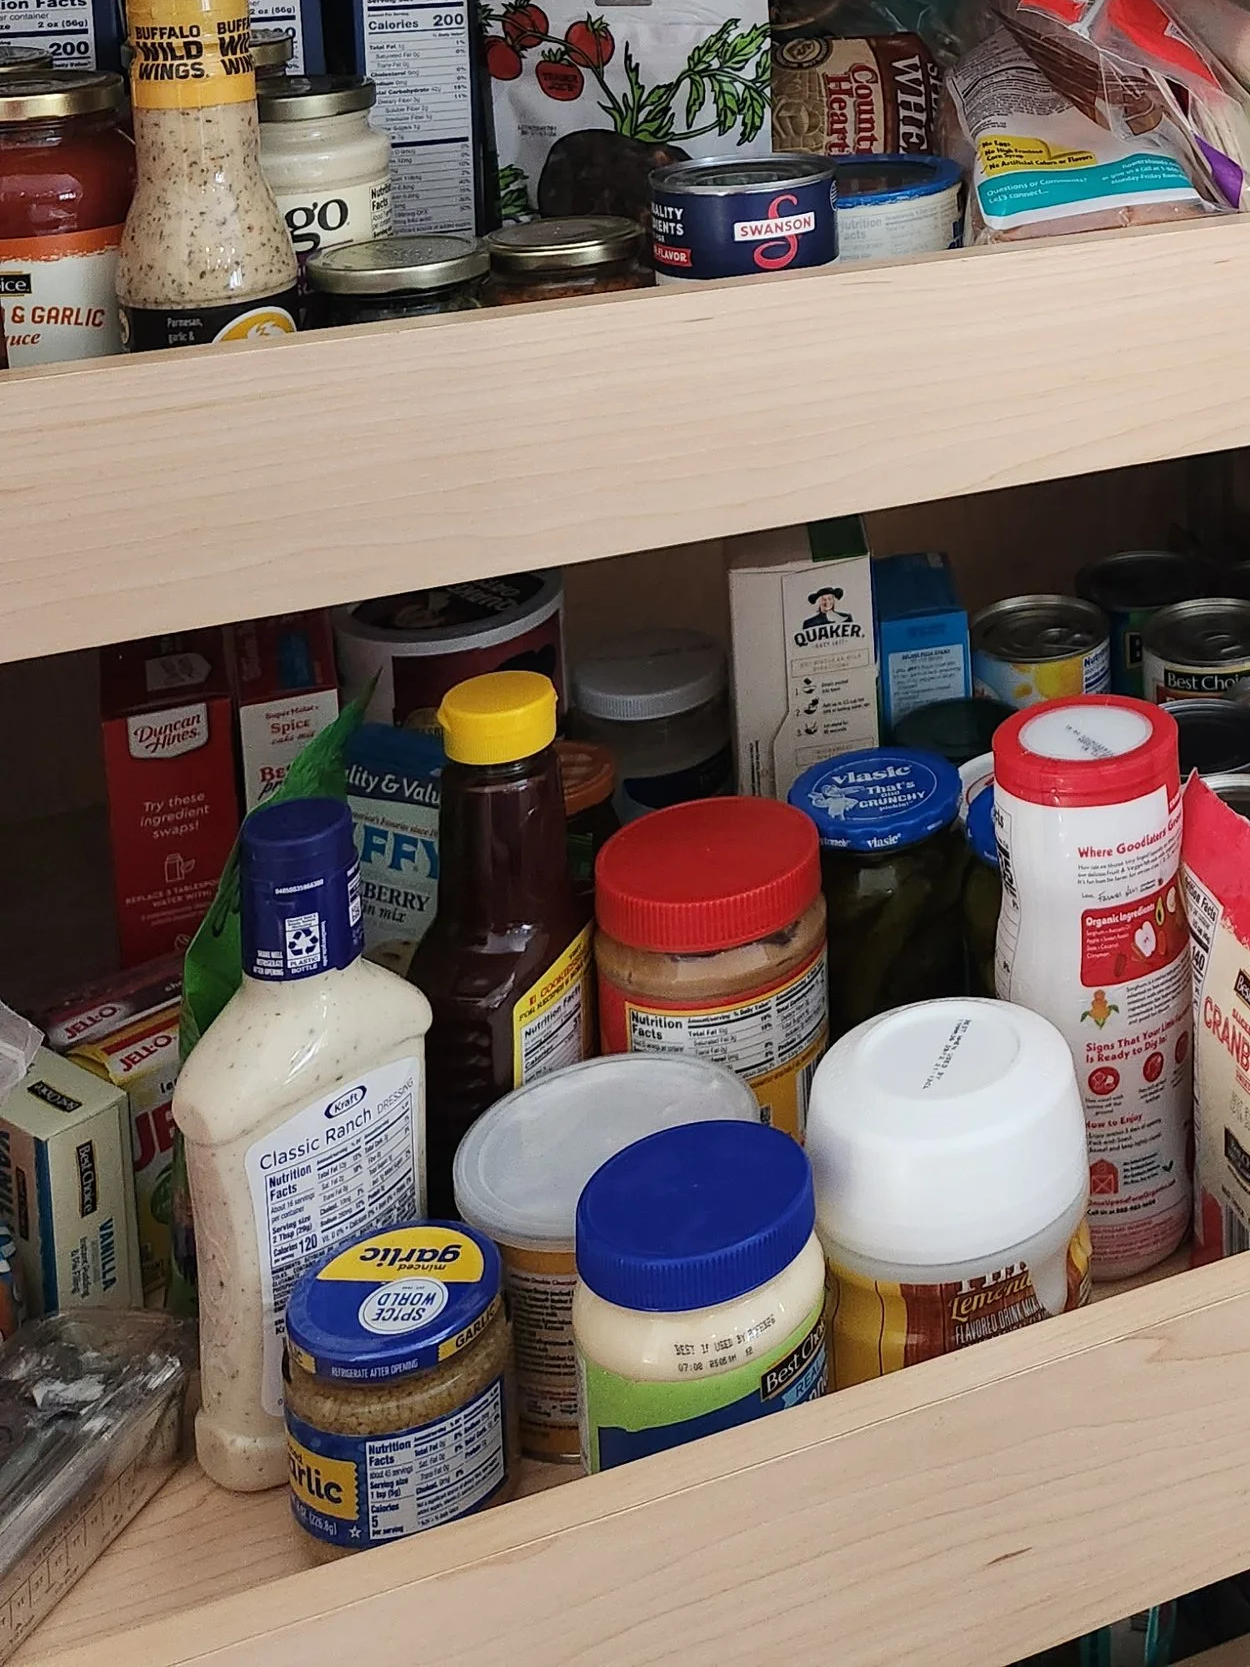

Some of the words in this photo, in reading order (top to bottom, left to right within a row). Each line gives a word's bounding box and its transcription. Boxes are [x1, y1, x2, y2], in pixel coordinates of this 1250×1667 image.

[9, 11, 50, 21] container
[61, 19, 88, 30] (56g)
[368, 19, 420, 31] Calories
[432, 13, 465, 27] 200
[135, 24, 201, 39] BUFFALO
[50, 40, 90, 57] 200
[136, 40, 204, 62] WILD
[822, 72, 854, 156] Heart
[1001, 158, 1034, 168] Artificial
[1068, 153, 1093, 164] Flavors
[987, 181, 1028, 197] Questions
[1039, 177, 1088, 186] Comments?
[739, 215, 812, 238] SWANSON
[11, 305, 25, 324] &
[31, 305, 105, 328] GARLIC
[167, 317, 203, 329] Parmesan,
[794, 623, 863, 647] QUAKER
[1167, 671, 1199, 690] Best
[133, 713, 202, 744] Duncan
[271, 718, 311, 736] Spice
[145, 729, 198, 754] Hines
[381, 774, 400, 794] &
[403, 778, 440, 805] Valu
[858, 790, 927, 809] CRUNCHY
[143, 800, 164, 815] Try
[168, 792, 206, 808] these
[139, 804, 211, 829] ingredient
[152, 821, 199, 841] swaps!
[1078, 846, 1113, 859] Where
[152, 896, 182, 909] WATER
[1199, 895, 1216, 923] Facts
[379, 904, 407, 923] mix
[1085, 914, 1119, 929] Organic
[1119, 902, 1156, 922] Ingredients
[290, 955, 320, 968] PLASTIC
[1191, 945, 1206, 972] 140
[291, 963, 319, 975] BOTTLE
[523, 1003, 563, 1039] Nutrition
[562, 984, 582, 1009] Facts
[631, 1010, 683, 1030] Nutrition
[632, 1024, 663, 1041] Facts
[1086, 1039, 1115, 1054] Signs
[1117, 1035, 1141, 1049] That
[1097, 1047, 1130, 1064] Ready
[1132, 1044, 1143, 1056] to
[1144, 1038, 1159, 1054] Dig
[334, 1091, 360, 1114] Kraft
[259, 1136, 321, 1171] Classic
[325, 1108, 373, 1146] Ranch
[376, 1077, 415, 1115] DRESSING
[1107, 1118, 1118, 1128] to
[1119, 1112, 1143, 1128] Enjoy
[76, 1144, 92, 1175] Best
[268, 1164, 312, 1189] Nutrition
[269, 1185, 298, 1202] Facts
[270, 1202, 286, 1215] About
[272, 1220, 297, 1235] Serving
[297, 1214, 312, 1226] size
[273, 1242, 298, 1258] Calories
[298, 1232, 319, 1255] 120
[278, 1229, 296, 1243] Tbsp
[99, 1216, 118, 1292] VANILLA
[359, 1243, 463, 1267] garlic
[396, 1263, 447, 1272] minced
[376, 1292, 437, 1307] WORLD
[370, 1306, 427, 1322] SPICE
[954, 1312, 999, 1346] FLAVORED
[997, 1301, 1024, 1330] DRINK
[455, 1302, 497, 1350] GARLIC
[673, 1343, 696, 1357] BEST
[714, 1337, 734, 1353] USED
[331, 1363, 370, 1379] REFRIGERATE
[370, 1364, 388, 1378] AFTER
[388, 1358, 419, 1376] OPENING
[765, 1360, 801, 1393] Best
[368, 1439, 412, 1456] Nutrition
[369, 1454, 395, 1468] Facts
[370, 1479, 394, 1491] Serving
[395, 1477, 409, 1486] size
[371, 1502, 400, 1515] Calories
[371, 1514, 379, 1529] 5
